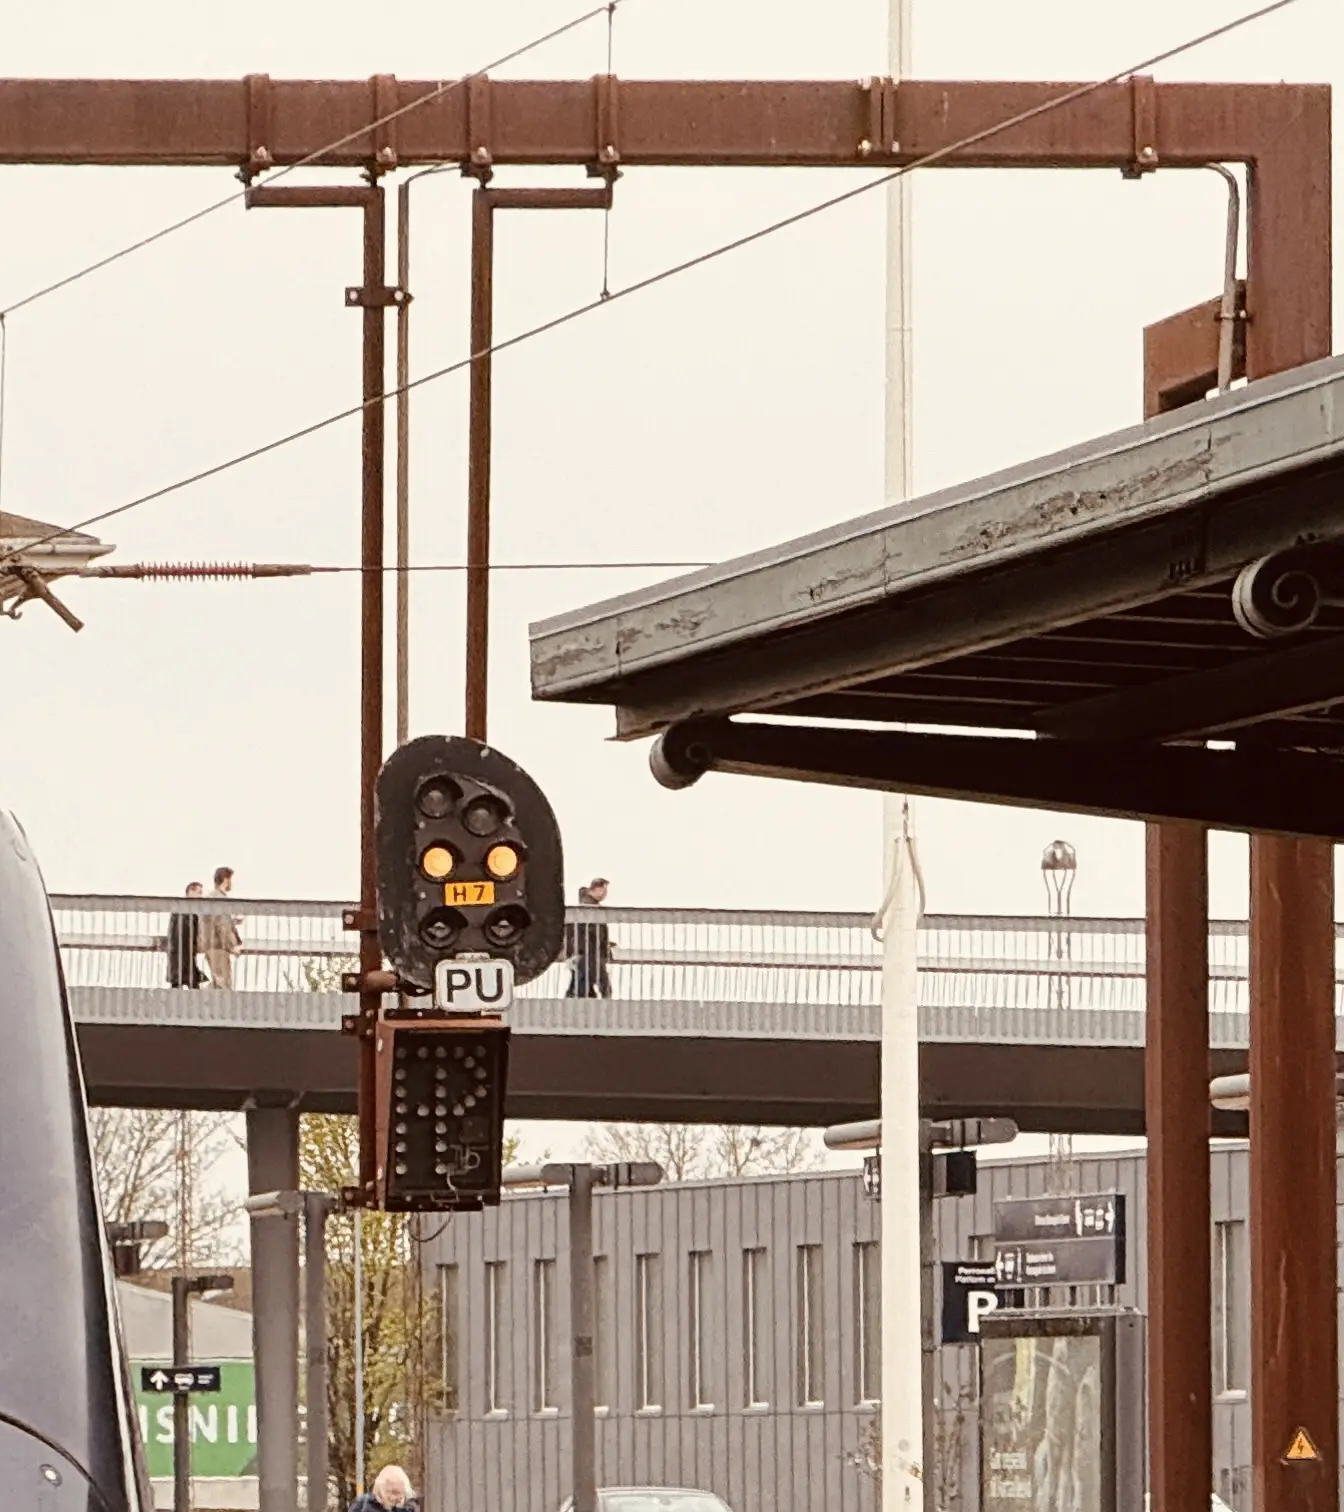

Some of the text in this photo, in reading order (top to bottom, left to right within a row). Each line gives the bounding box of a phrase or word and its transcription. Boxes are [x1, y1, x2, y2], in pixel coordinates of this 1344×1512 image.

[452, 884, 486, 902] H 7
[446, 968, 504, 1003] PU
[967, 1290, 1000, 1334] P
